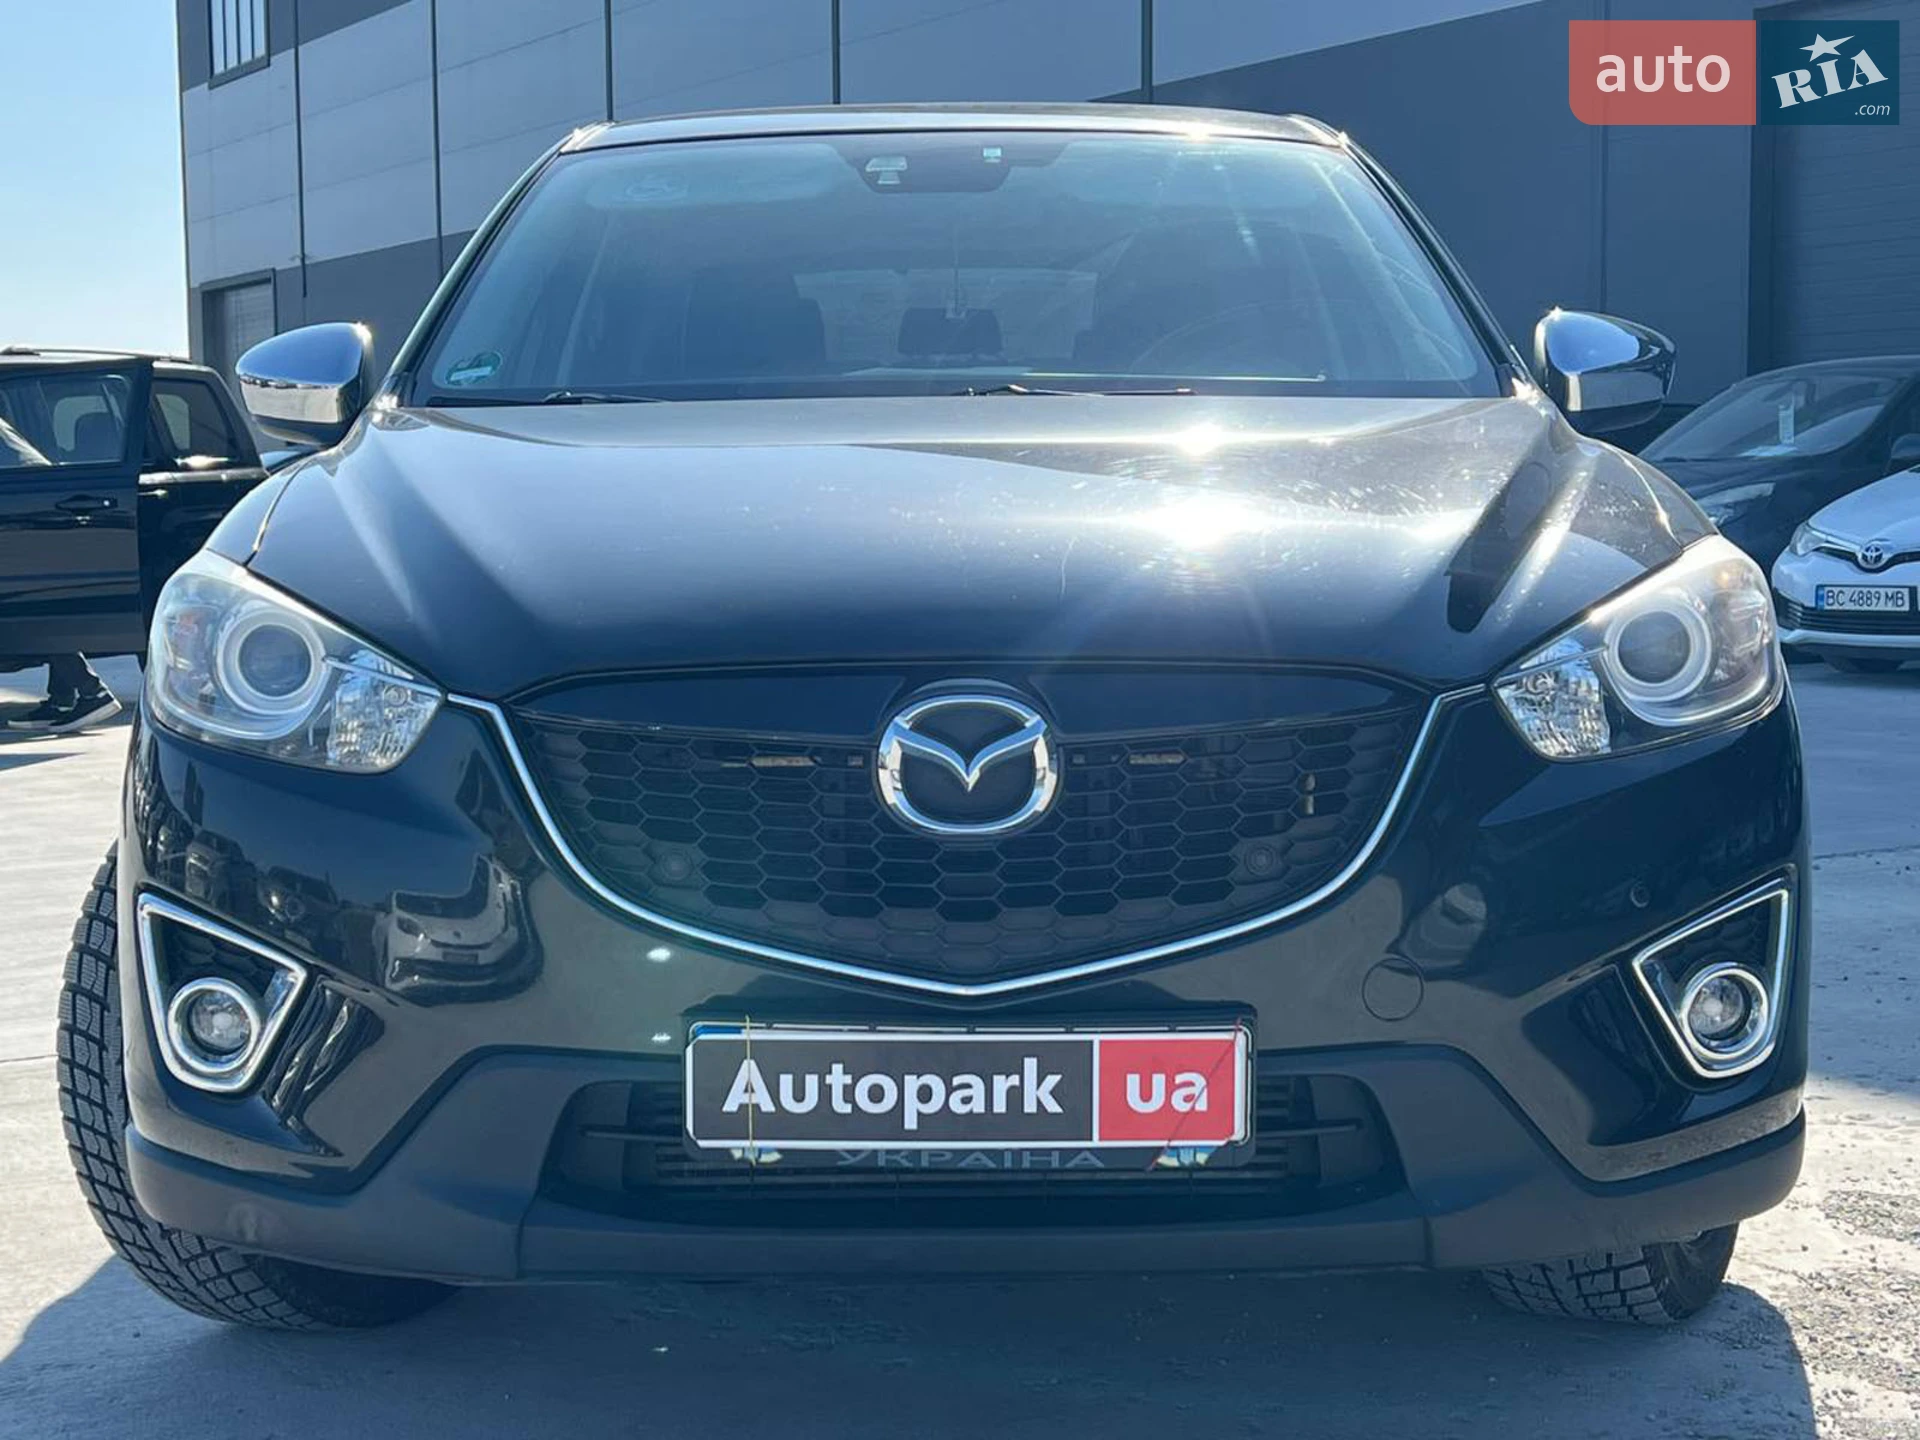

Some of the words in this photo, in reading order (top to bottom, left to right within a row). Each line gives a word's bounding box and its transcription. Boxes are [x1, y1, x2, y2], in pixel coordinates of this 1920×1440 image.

[1826, 591, 1845, 606] BC
[1848, 591, 1881, 607] 4889
[1885, 591, 1905, 607] MB
[721, 1057, 1064, 1130] Autopark
[1125, 1071, 1208, 1114] ua
